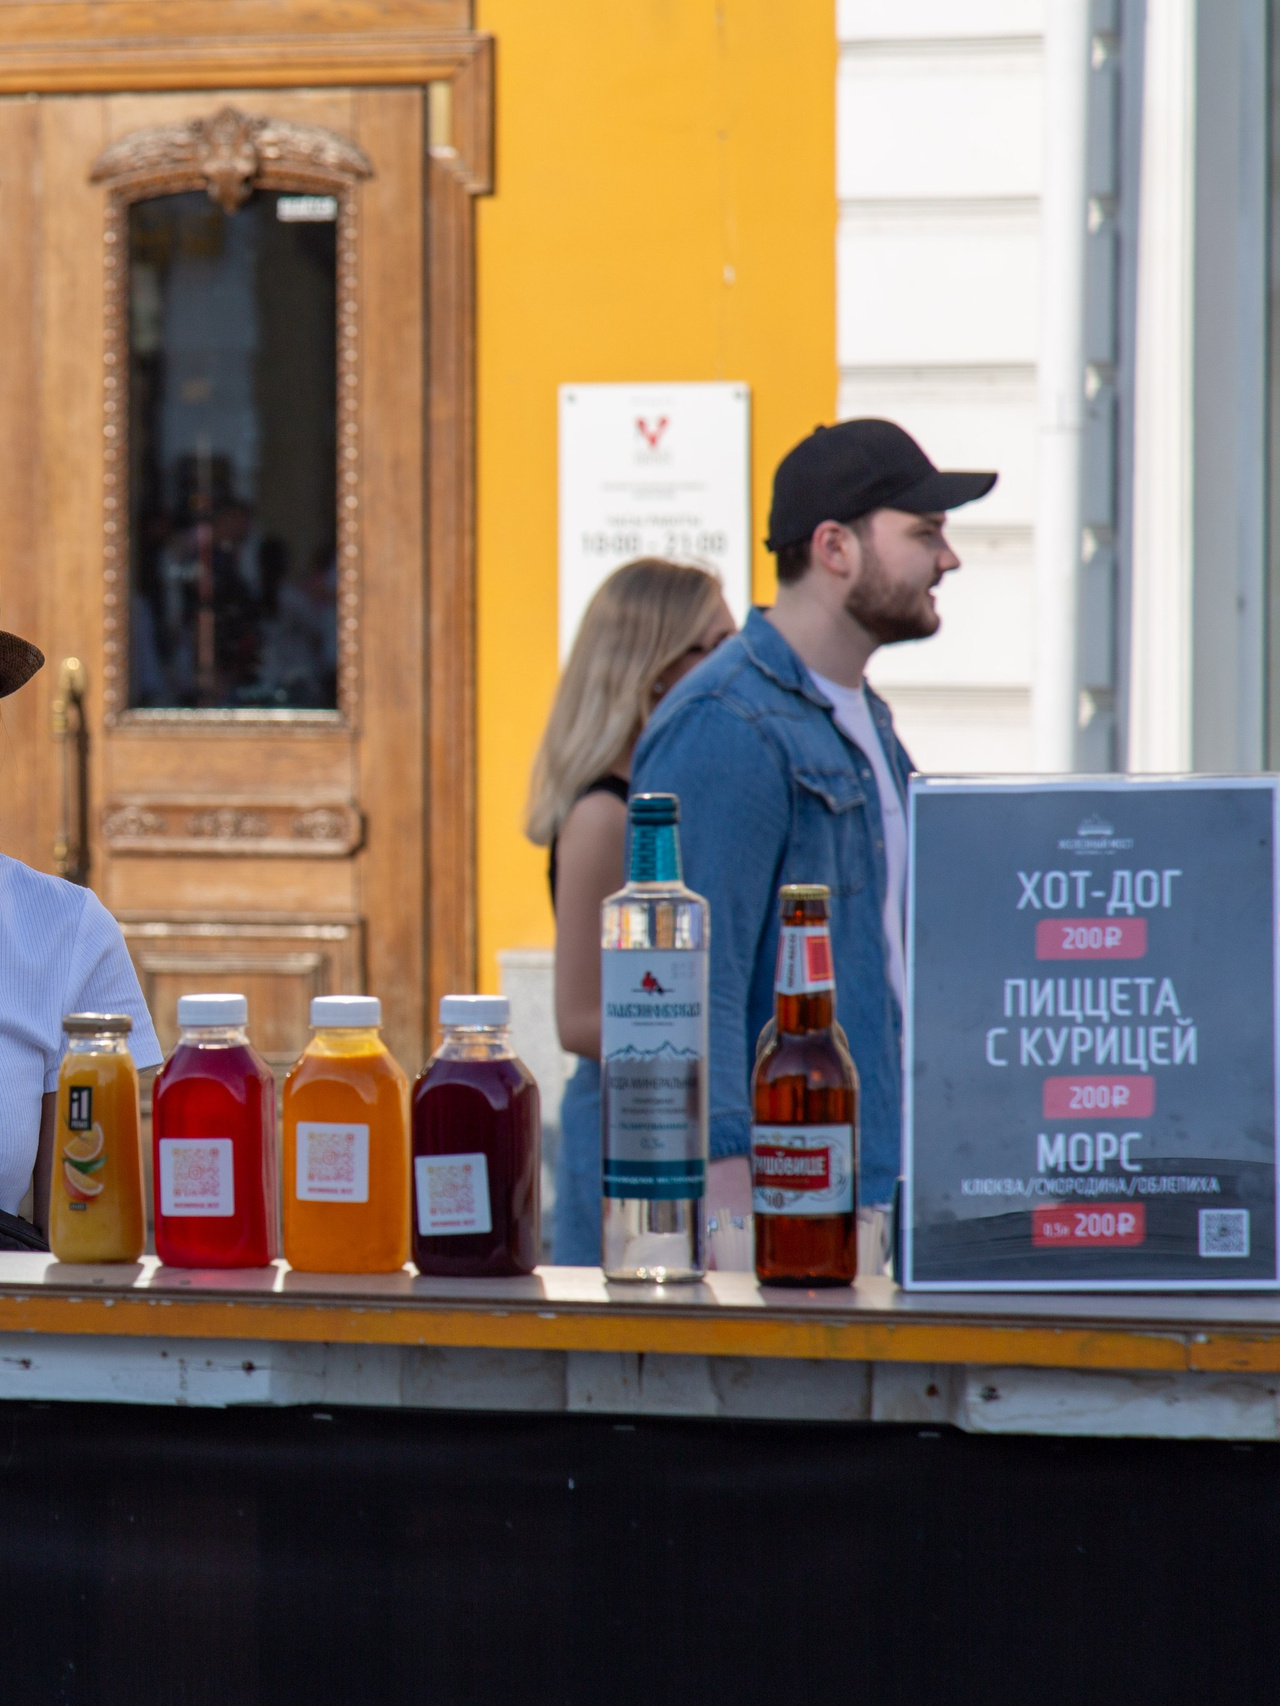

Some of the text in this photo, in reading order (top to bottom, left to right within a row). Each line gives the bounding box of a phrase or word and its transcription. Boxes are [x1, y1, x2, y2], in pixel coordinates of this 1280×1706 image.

[1016, 869, 1183, 916] ХОТ-ДОГ
[1061, 926, 1122, 949] 200₽
[1003, 977, 1181, 1024] ПИЦЦЕТА
[986, 1017, 1198, 1073] С КУРИЦЕЙ
[1068, 1085, 1129, 1109] 200₽
[1036, 1131, 1144, 1173] МОРС
[1074, 1212, 1136, 1236] 200₽
